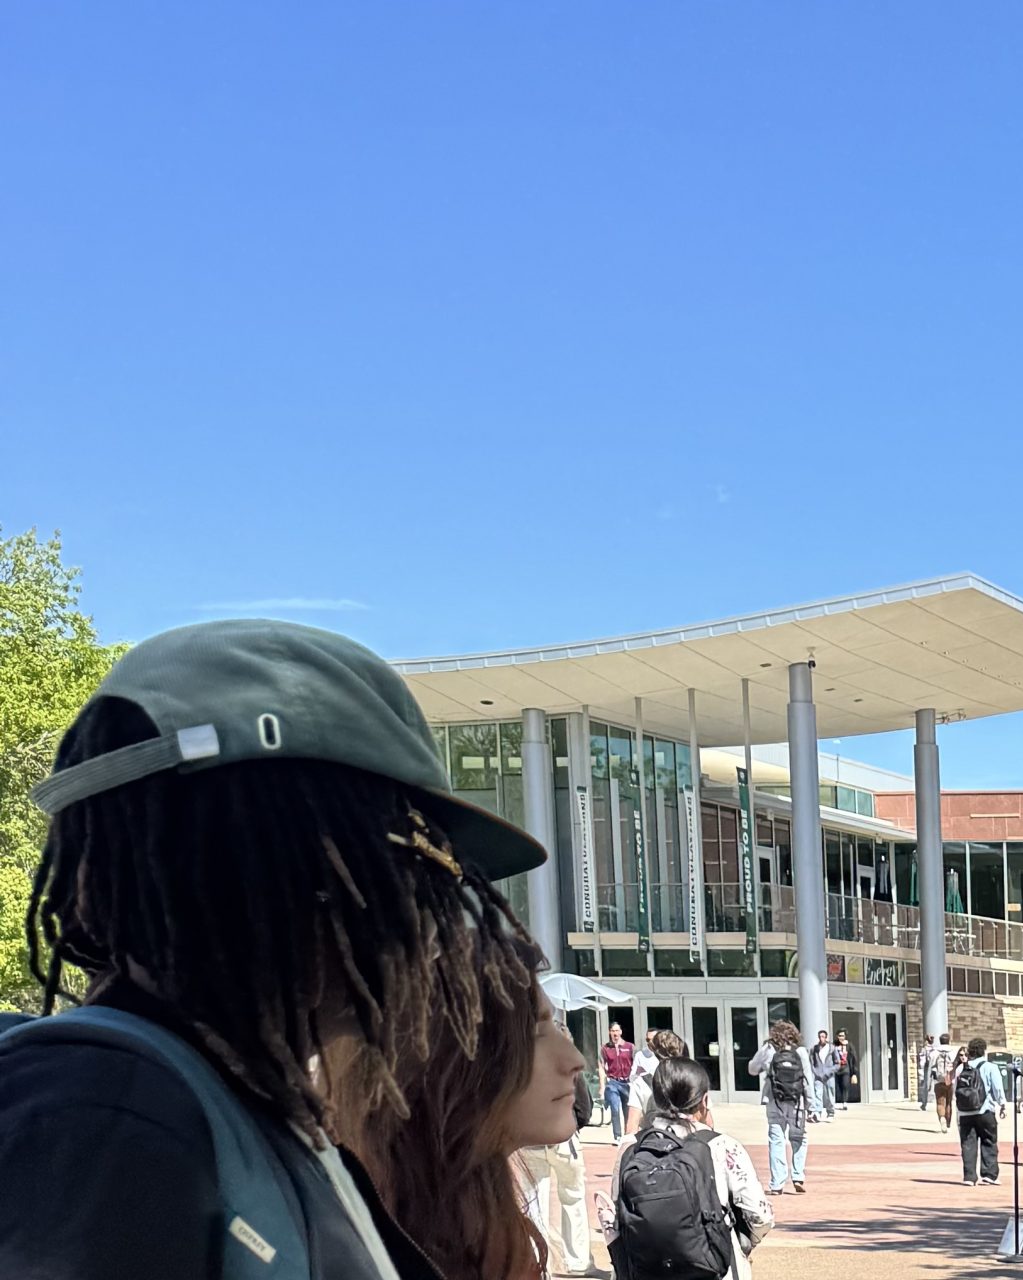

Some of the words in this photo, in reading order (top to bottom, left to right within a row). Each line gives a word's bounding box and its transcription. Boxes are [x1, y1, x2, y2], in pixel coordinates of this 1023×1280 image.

[633, 809, 641, 829] BE
[740, 808, 749, 829] BE
[742, 832, 750, 853] TO
[744, 857, 754, 913] PROUD
